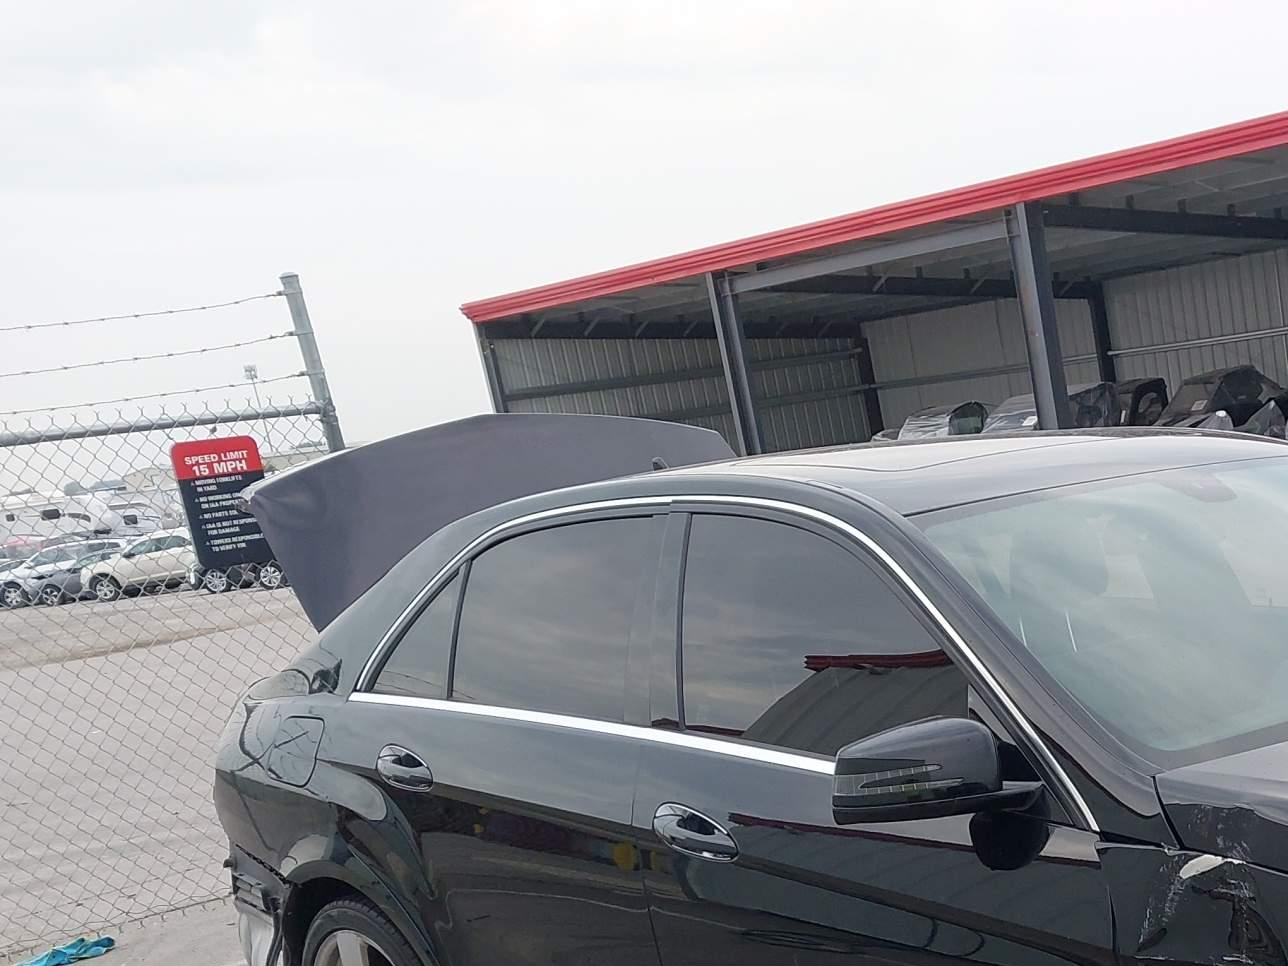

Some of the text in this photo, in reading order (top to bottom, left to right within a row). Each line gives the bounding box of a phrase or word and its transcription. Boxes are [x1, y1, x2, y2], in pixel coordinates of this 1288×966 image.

[184, 450, 248, 465] SPEED LIMIT
[192, 459, 247, 476] 15 MPH
